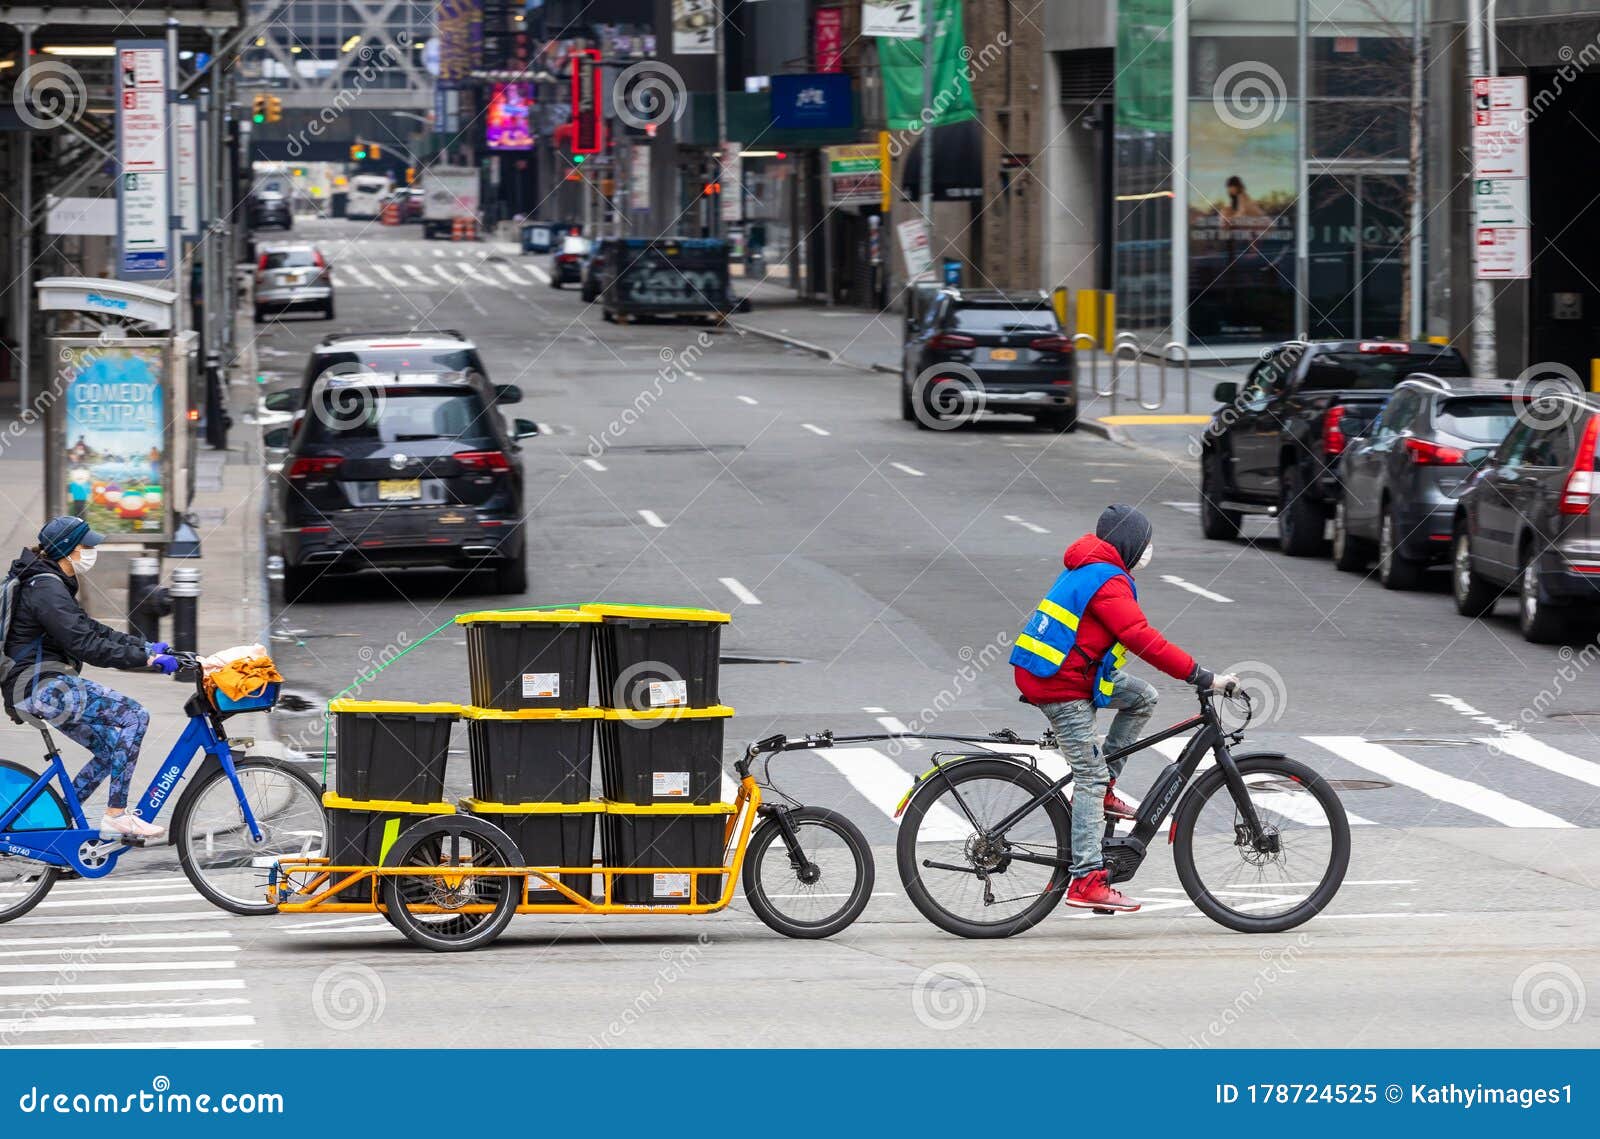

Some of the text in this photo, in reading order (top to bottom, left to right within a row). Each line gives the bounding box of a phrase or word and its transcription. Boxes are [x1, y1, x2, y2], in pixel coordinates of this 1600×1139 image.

[75, 383, 157, 402] COMEDY
[76, 404, 156, 424] CENTRAL
[1150, 775, 1182, 825] RALEIGH
[8, 845, 30, 856] 16740
